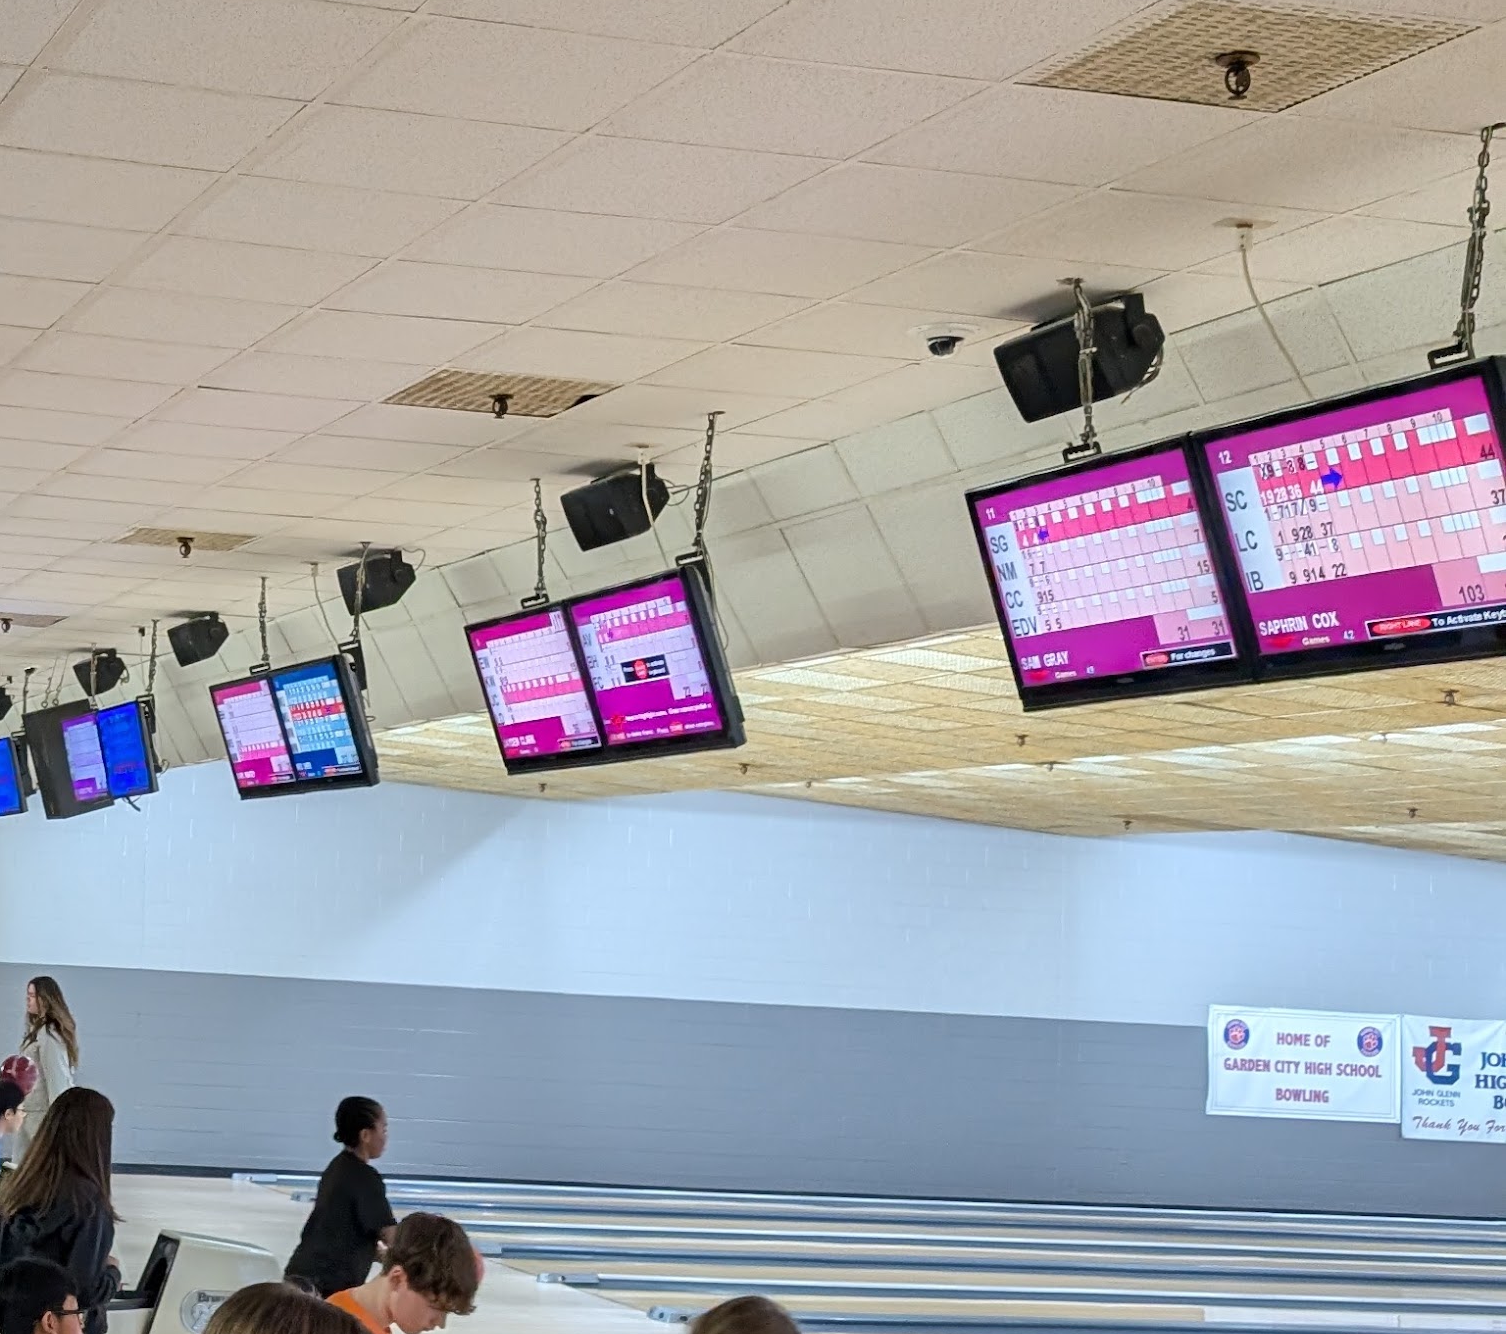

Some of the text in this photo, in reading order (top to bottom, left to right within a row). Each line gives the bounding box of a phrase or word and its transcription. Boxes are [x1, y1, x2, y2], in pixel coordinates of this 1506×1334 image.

[1218, 449, 1232, 464] 12
[1225, 489, 1248, 512] SC
[1321, 521, 1334, 536] 37
[990, 534, 1009, 555] SG
[1234, 529, 1258, 552] LC
[996, 561, 1018, 581] NM
[1197, 559, 1210, 575] 15
[1332, 562, 1348, 578] 22
[1004, 589, 1024, 609] CC
[1459, 585, 1485, 604] 103
[1012, 616, 1037, 637] EDV
[1258, 611, 1340, 637] SAPHRIN COX
[1177, 625, 1190, 641] 31
[1043, 651, 1070, 667] GRAY
[1276, 1032, 1331, 1048] HOME OF
[1223, 1058, 1383, 1078] GARDEN CITY HIGH SCHOOL
[1275, 1088, 1329, 1103] BOWLING
[1412, 1088, 1461, 1098] JOHN GLENN
[1418, 1097, 1455, 1107] ROCKETS
[1412, 1115, 1506, 1136] Thank You For
